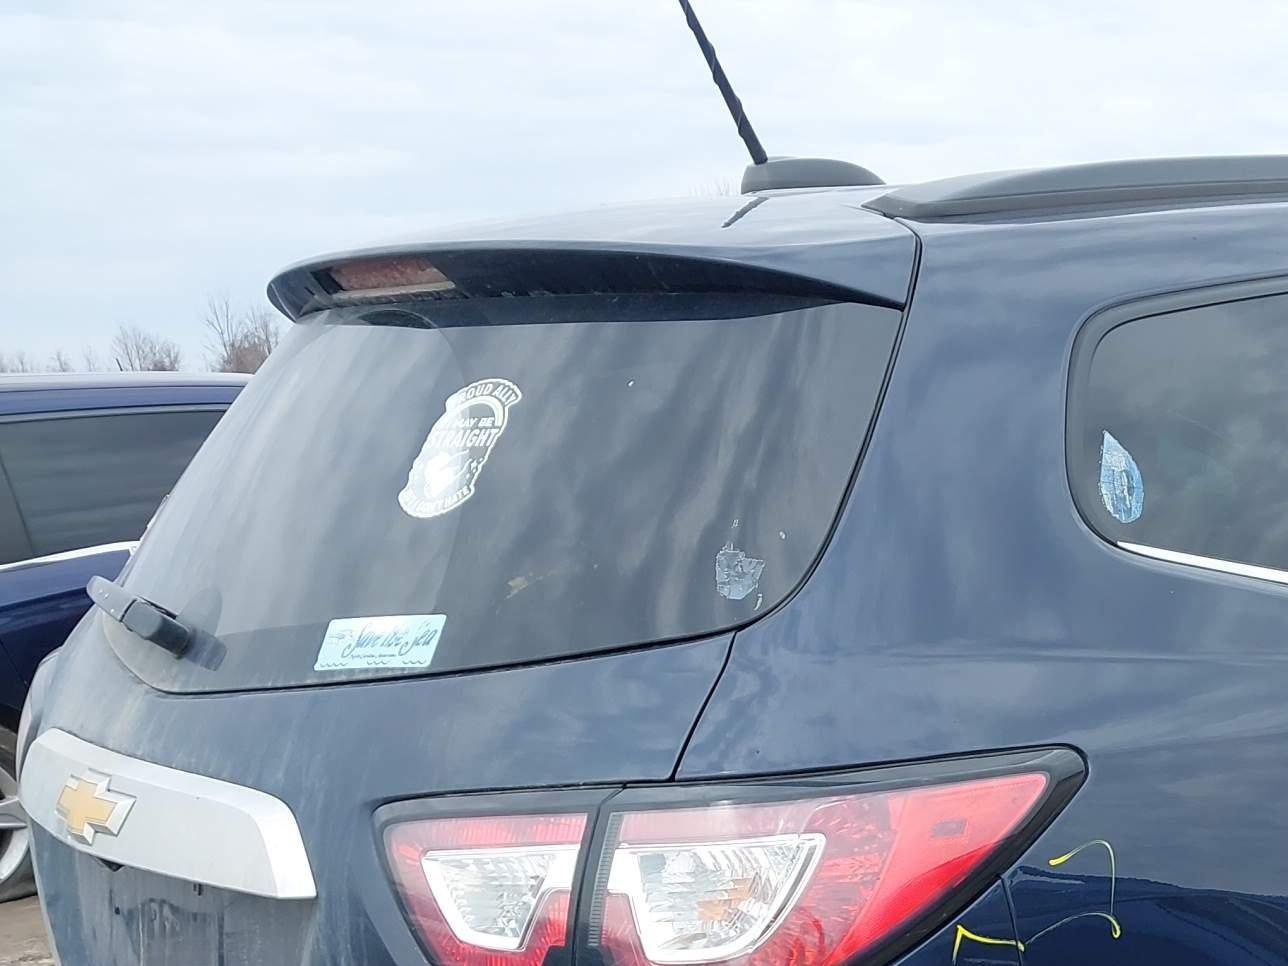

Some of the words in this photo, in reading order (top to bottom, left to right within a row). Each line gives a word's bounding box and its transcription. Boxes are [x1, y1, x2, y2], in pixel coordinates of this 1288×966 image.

[493, 384, 517, 405] ALLY
[478, 416, 495, 427] BE
[427, 428, 500, 448] STRAIGHT
